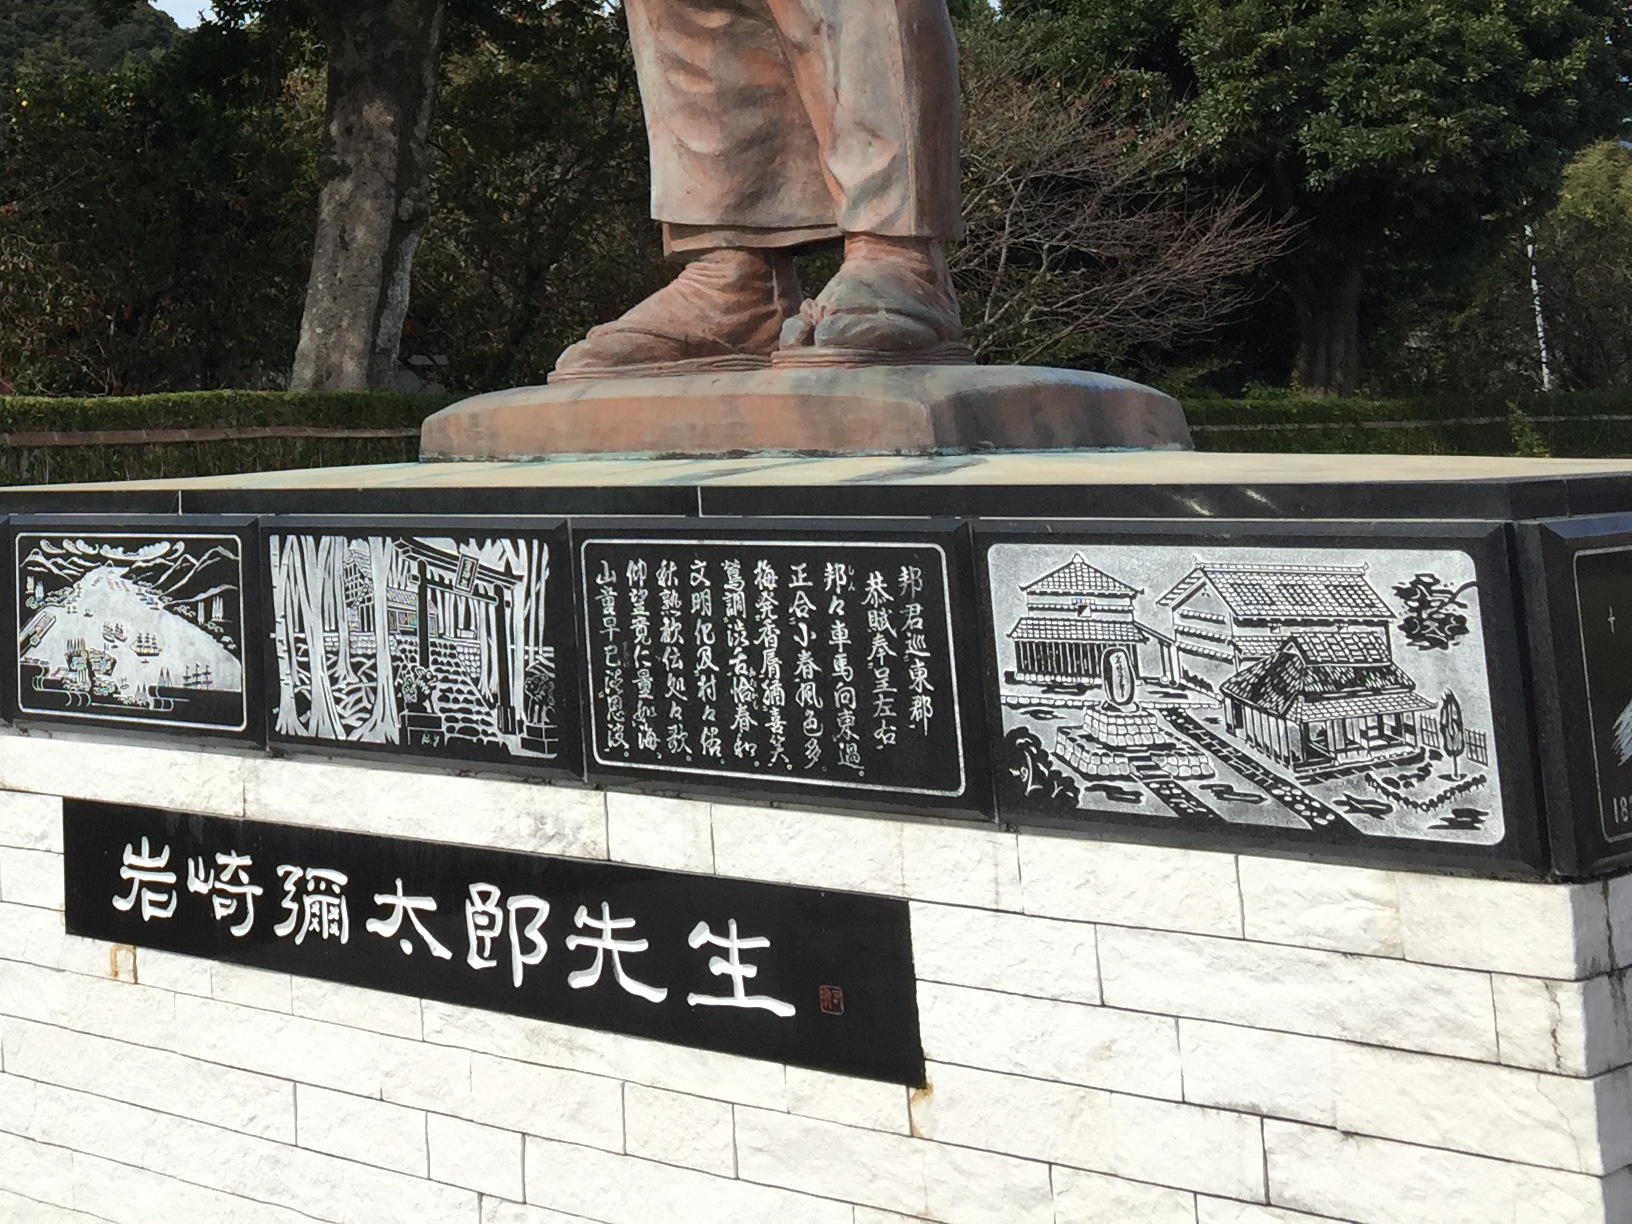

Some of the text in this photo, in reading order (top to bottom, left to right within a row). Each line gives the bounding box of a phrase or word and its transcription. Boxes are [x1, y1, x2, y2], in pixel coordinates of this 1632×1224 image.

[1612, 794, 1632, 824] 18
[112, 835, 796, 1019] 岩崎彌太郎先生
